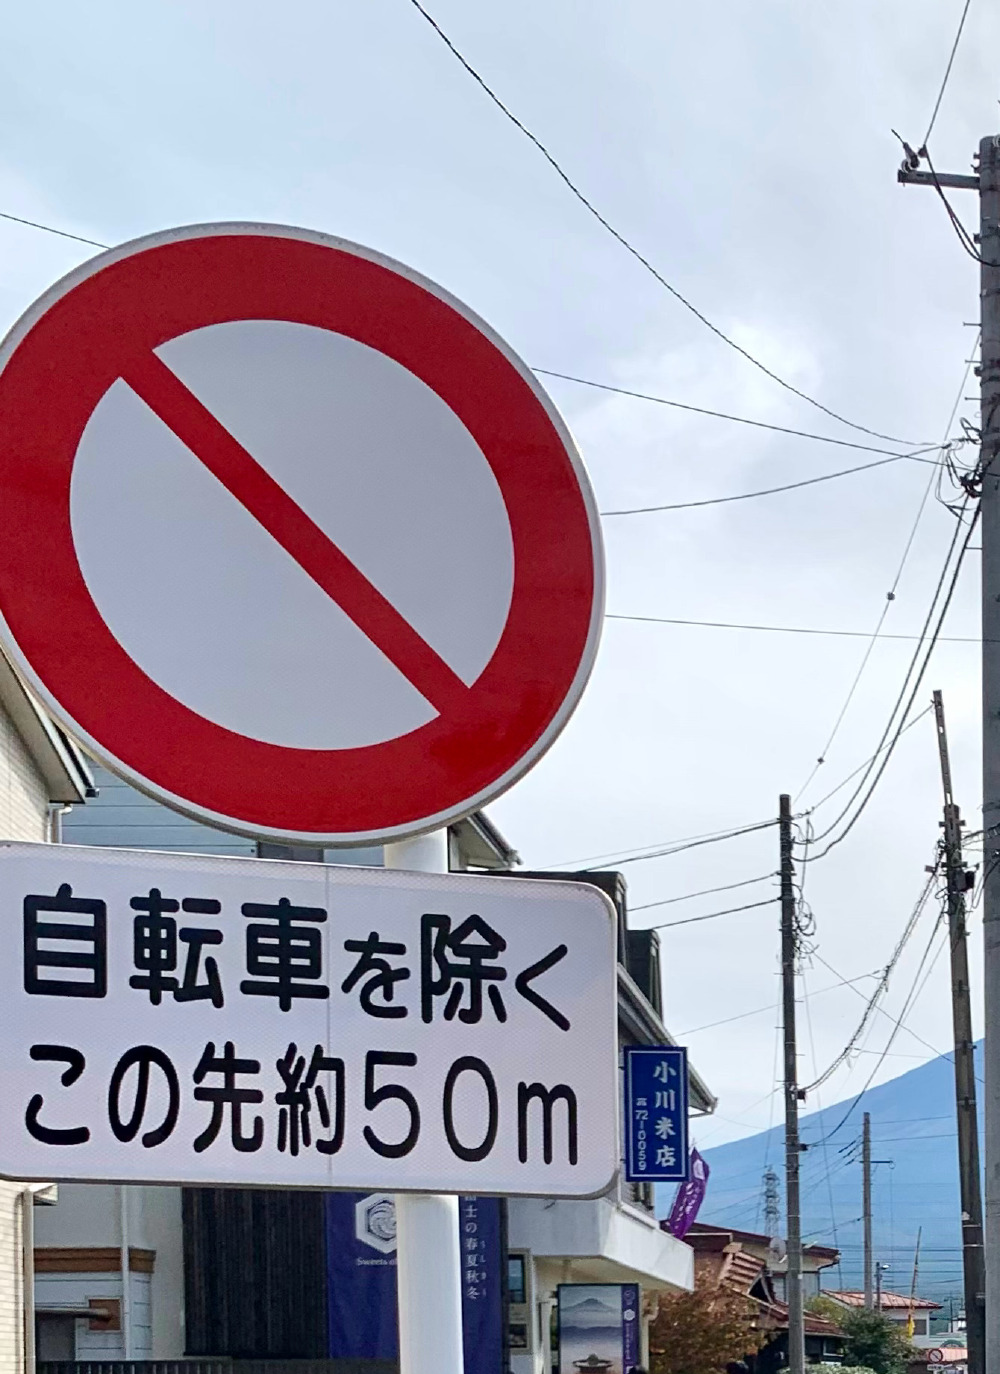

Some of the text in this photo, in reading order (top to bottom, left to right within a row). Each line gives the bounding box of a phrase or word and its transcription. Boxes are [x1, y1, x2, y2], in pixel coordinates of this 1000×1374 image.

[23, 883, 571, 1031] 自転車を除く
[25, 1041, 578, 1166] この先約50m
[653, 1060, 677, 1168] 小川米店
